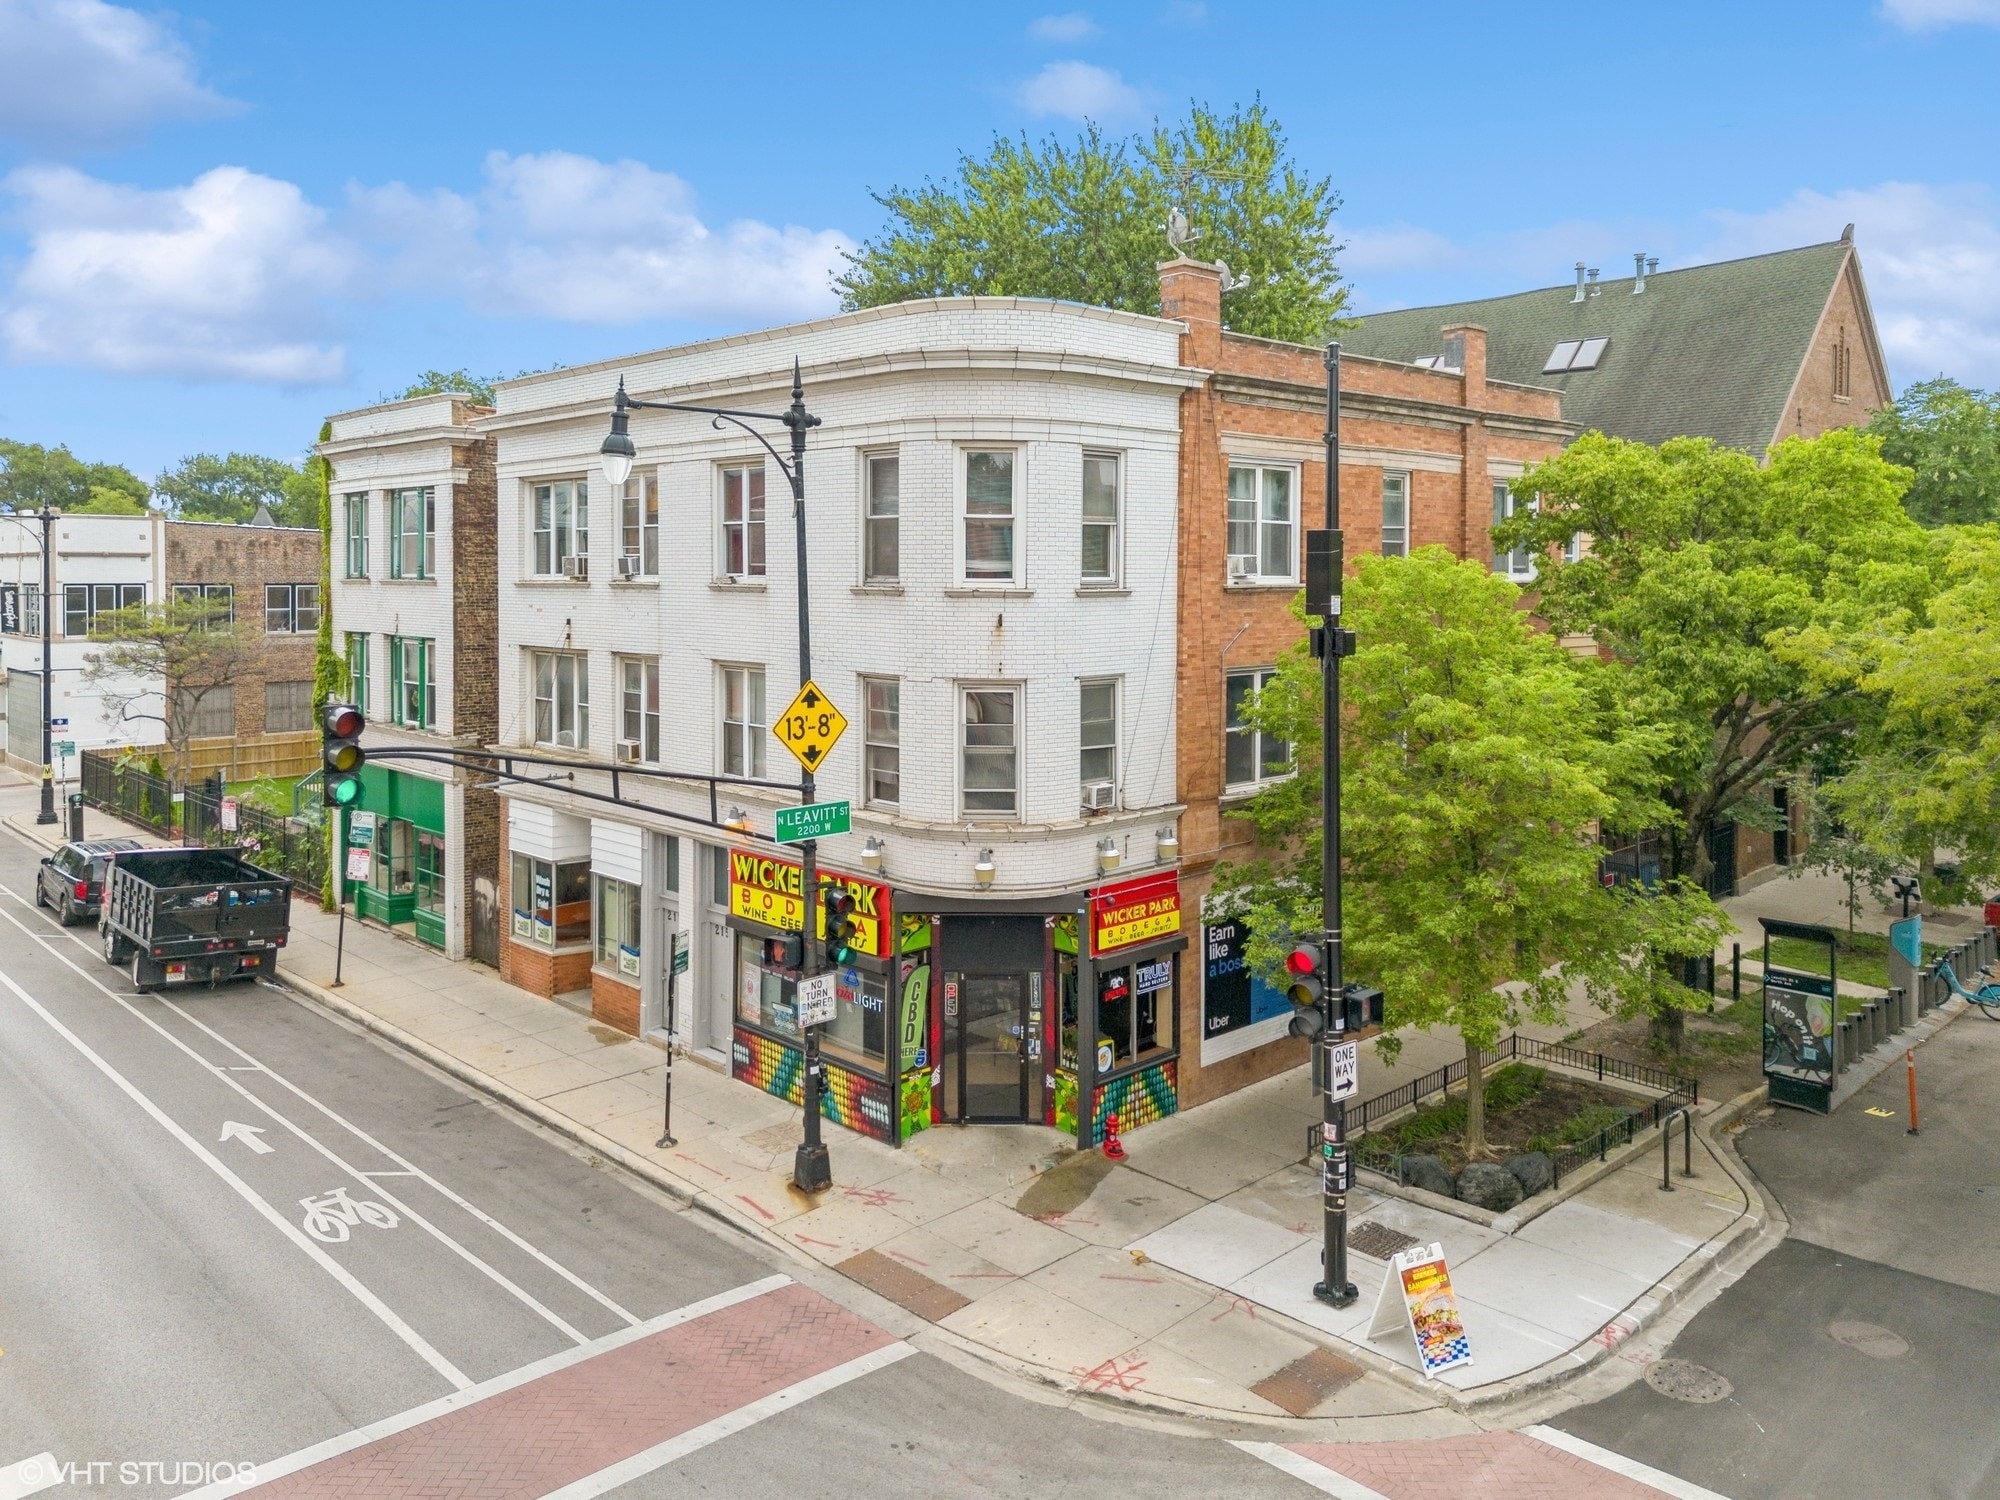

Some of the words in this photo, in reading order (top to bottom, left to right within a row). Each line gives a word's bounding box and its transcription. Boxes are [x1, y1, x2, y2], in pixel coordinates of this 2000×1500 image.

[777, 816, 784, 826] N
[787, 806, 838, 826] LEAVITT
[839, 805, 849, 816] ST
[797, 823, 820, 836] 2200
[824, 821, 832, 832] W
[820, 874, 878, 917] PRK
[741, 888, 868, 936] BODA
[742, 904, 768, 922] WINE
[780, 915, 804, 932] BEE
[1102, 904, 1147, 926] WICKER
[1149, 896, 1176, 915] PARK
[1107, 916, 1172, 938] BODEGA
[1107, 936, 1123, 945] WINE
[1129, 930, 1145, 940] BEER
[1150, 923, 1172, 935] SPIRITS
[1209, 925, 1235, 943] Earn
[1209, 943, 1229, 960] like
[1136, 961, 1171, 983] TRULY
[1209, 964, 1217, 977] a
[1219, 957, 1243, 975] bos
[806, 988, 828, 1001] TURN
[811, 979, 823, 990] NO
[1139, 980, 1151, 988] HARD
[853, 991, 883, 1013] LIGHT
[946, 984, 956, 1014] OPEN
[904, 981, 921, 1044] CBD
[1209, 1015, 1230, 1030] Uber
[1771, 999, 1796, 1019] Hop
[1795, 1018, 1808, 1034] on
[1803, 1035, 1814, 1046] it
[1335, 1046, 1355, 1064] ONE
[1334, 1060, 1355, 1079] WAY
